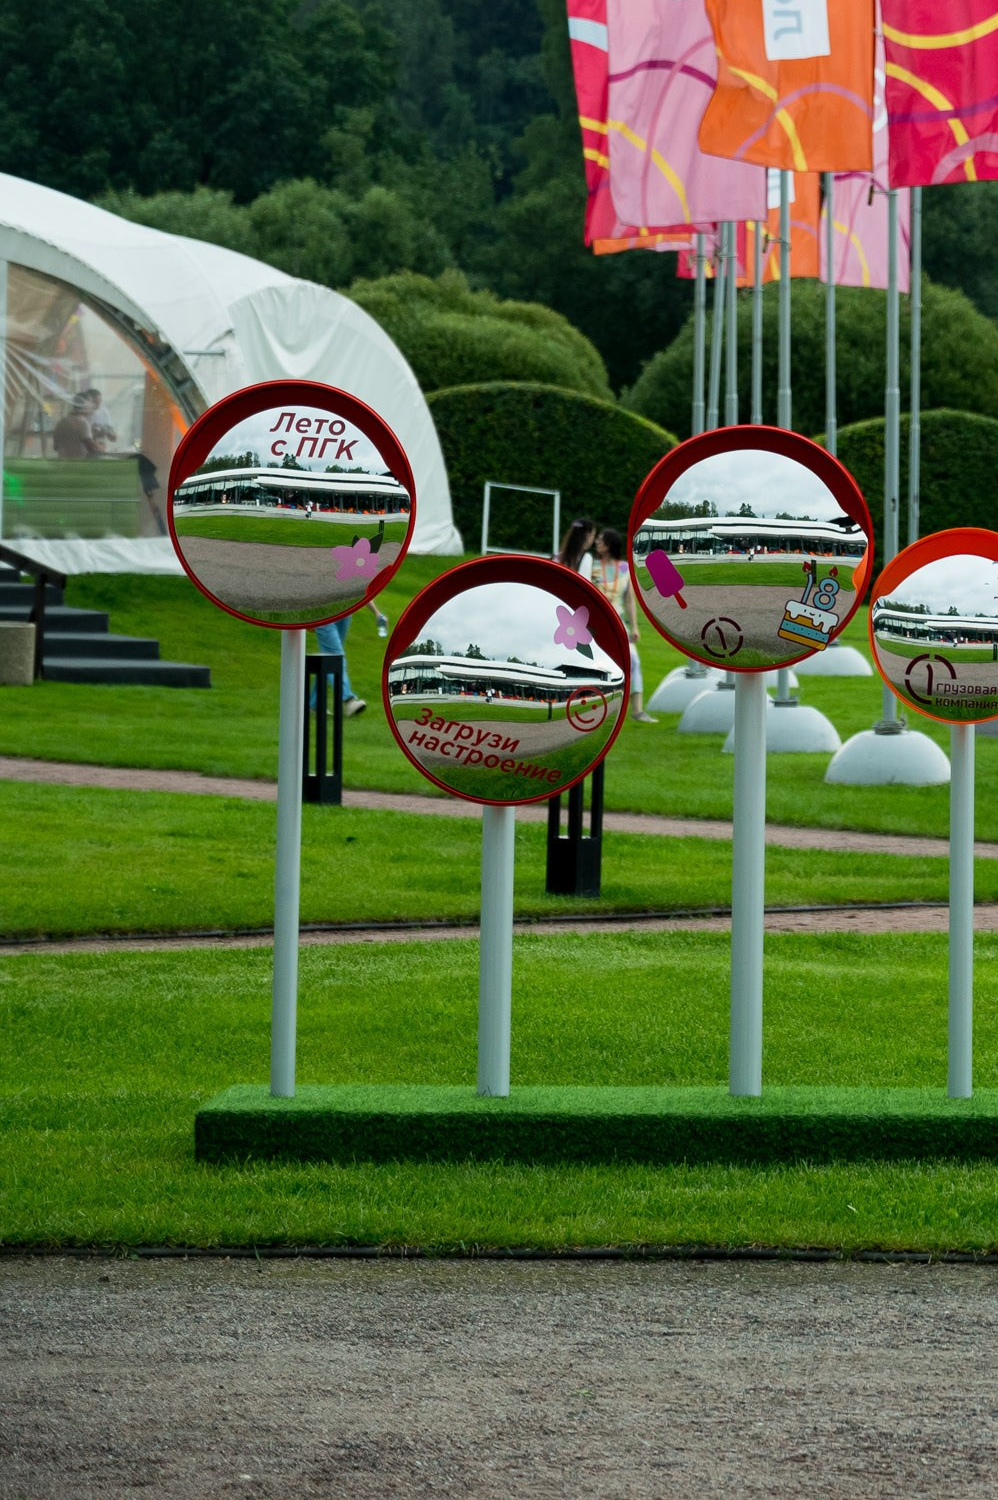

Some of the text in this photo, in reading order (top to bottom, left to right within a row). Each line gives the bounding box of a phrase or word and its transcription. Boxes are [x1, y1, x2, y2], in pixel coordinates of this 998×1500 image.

[269, 411, 346, 437] Лето
[270, 436, 360, 461] с ПГК
[936, 683, 998, 696] грузовая
[935, 698, 998, 710] компания
[414, 706, 520, 752] Загрузи
[408, 729, 562, 784] настроение
